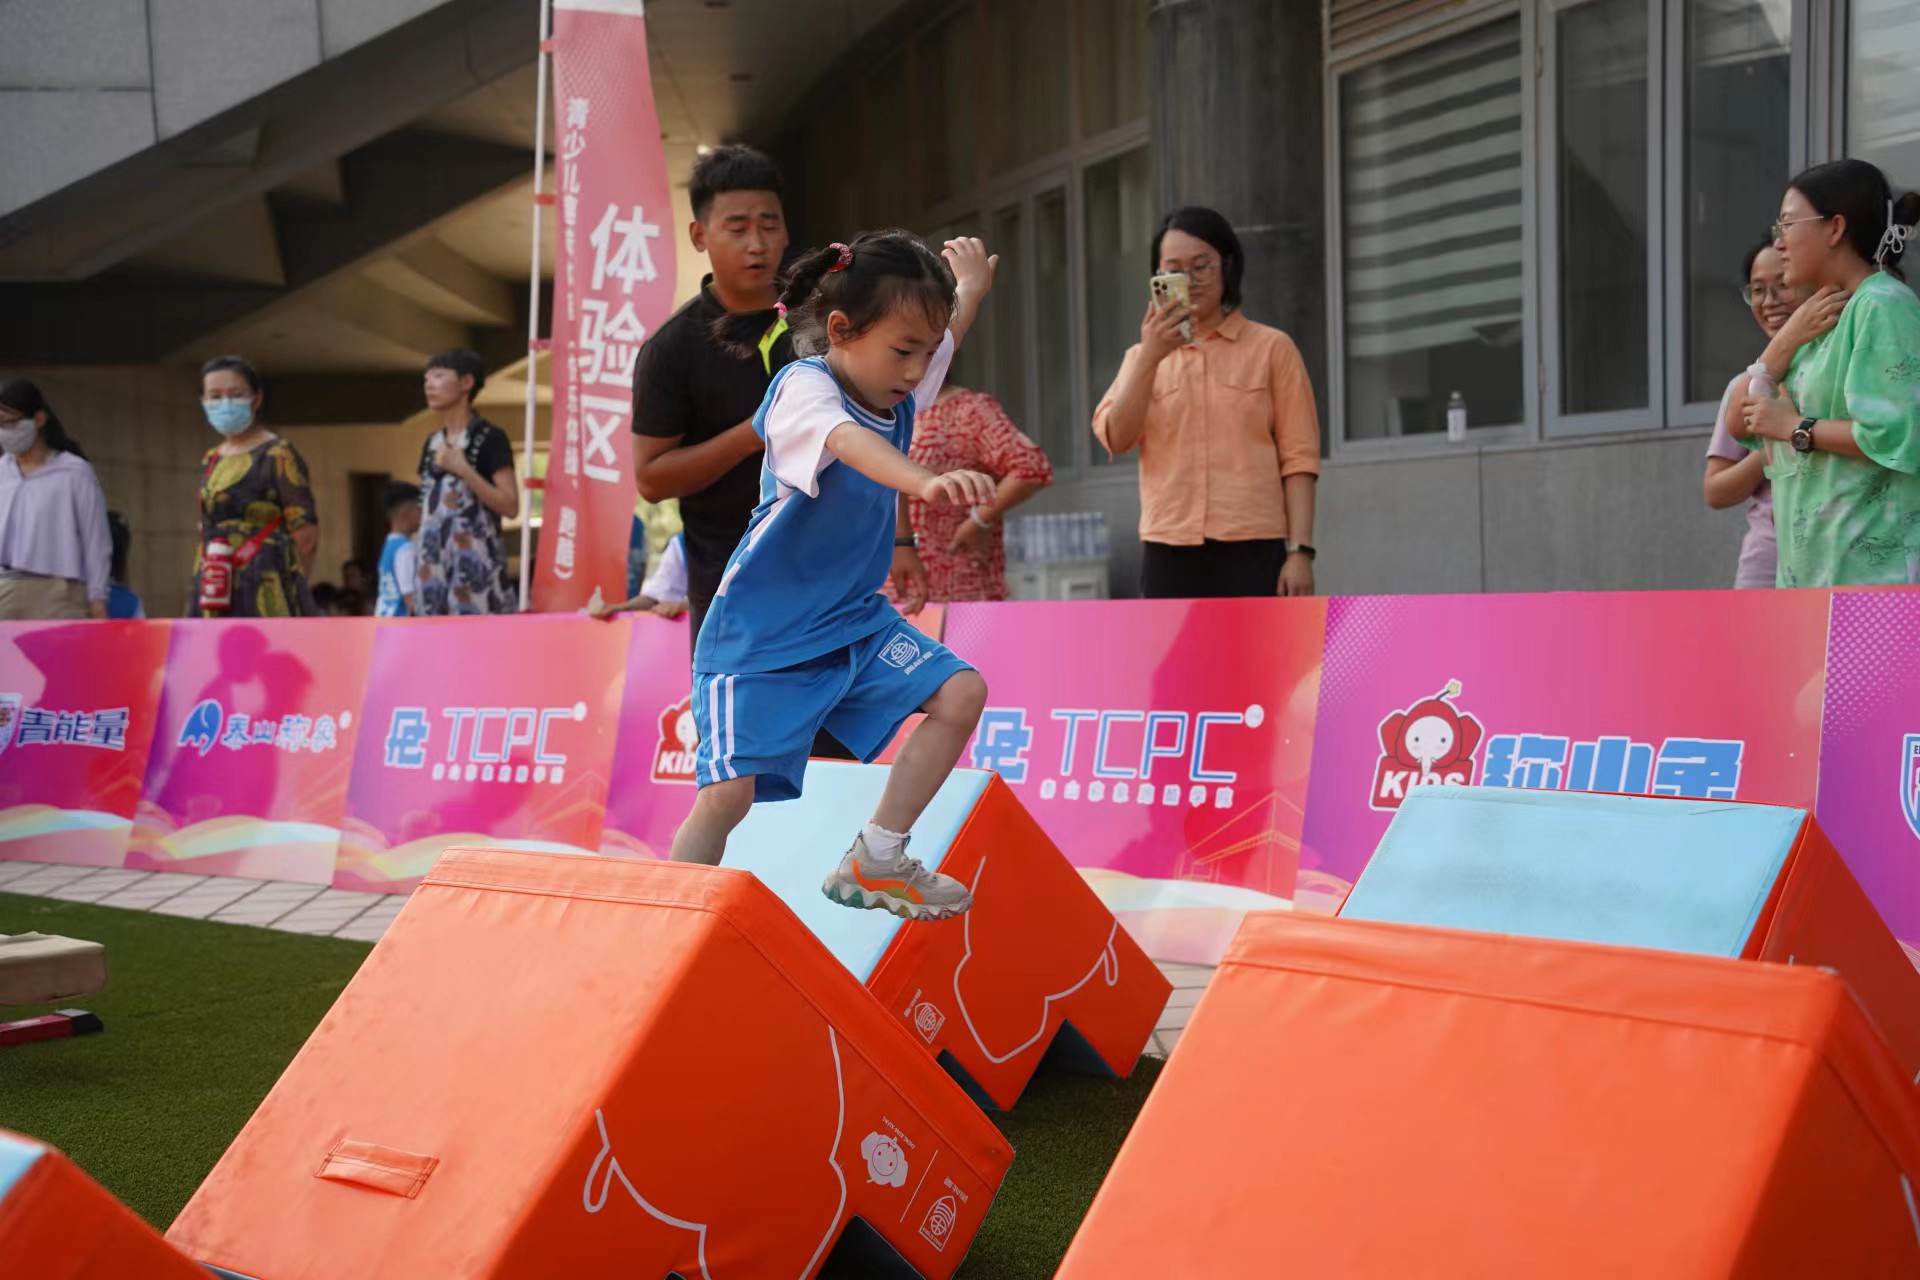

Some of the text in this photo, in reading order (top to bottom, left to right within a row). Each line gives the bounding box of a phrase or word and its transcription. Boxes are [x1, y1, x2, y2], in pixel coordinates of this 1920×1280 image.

[578, 203, 660, 484] 体验区
[18, 708, 129, 751] 青能量
[443, 707, 573, 763] TCPC
[1051, 709, 1244, 782] TCPC
[657, 750, 696, 773] KID
